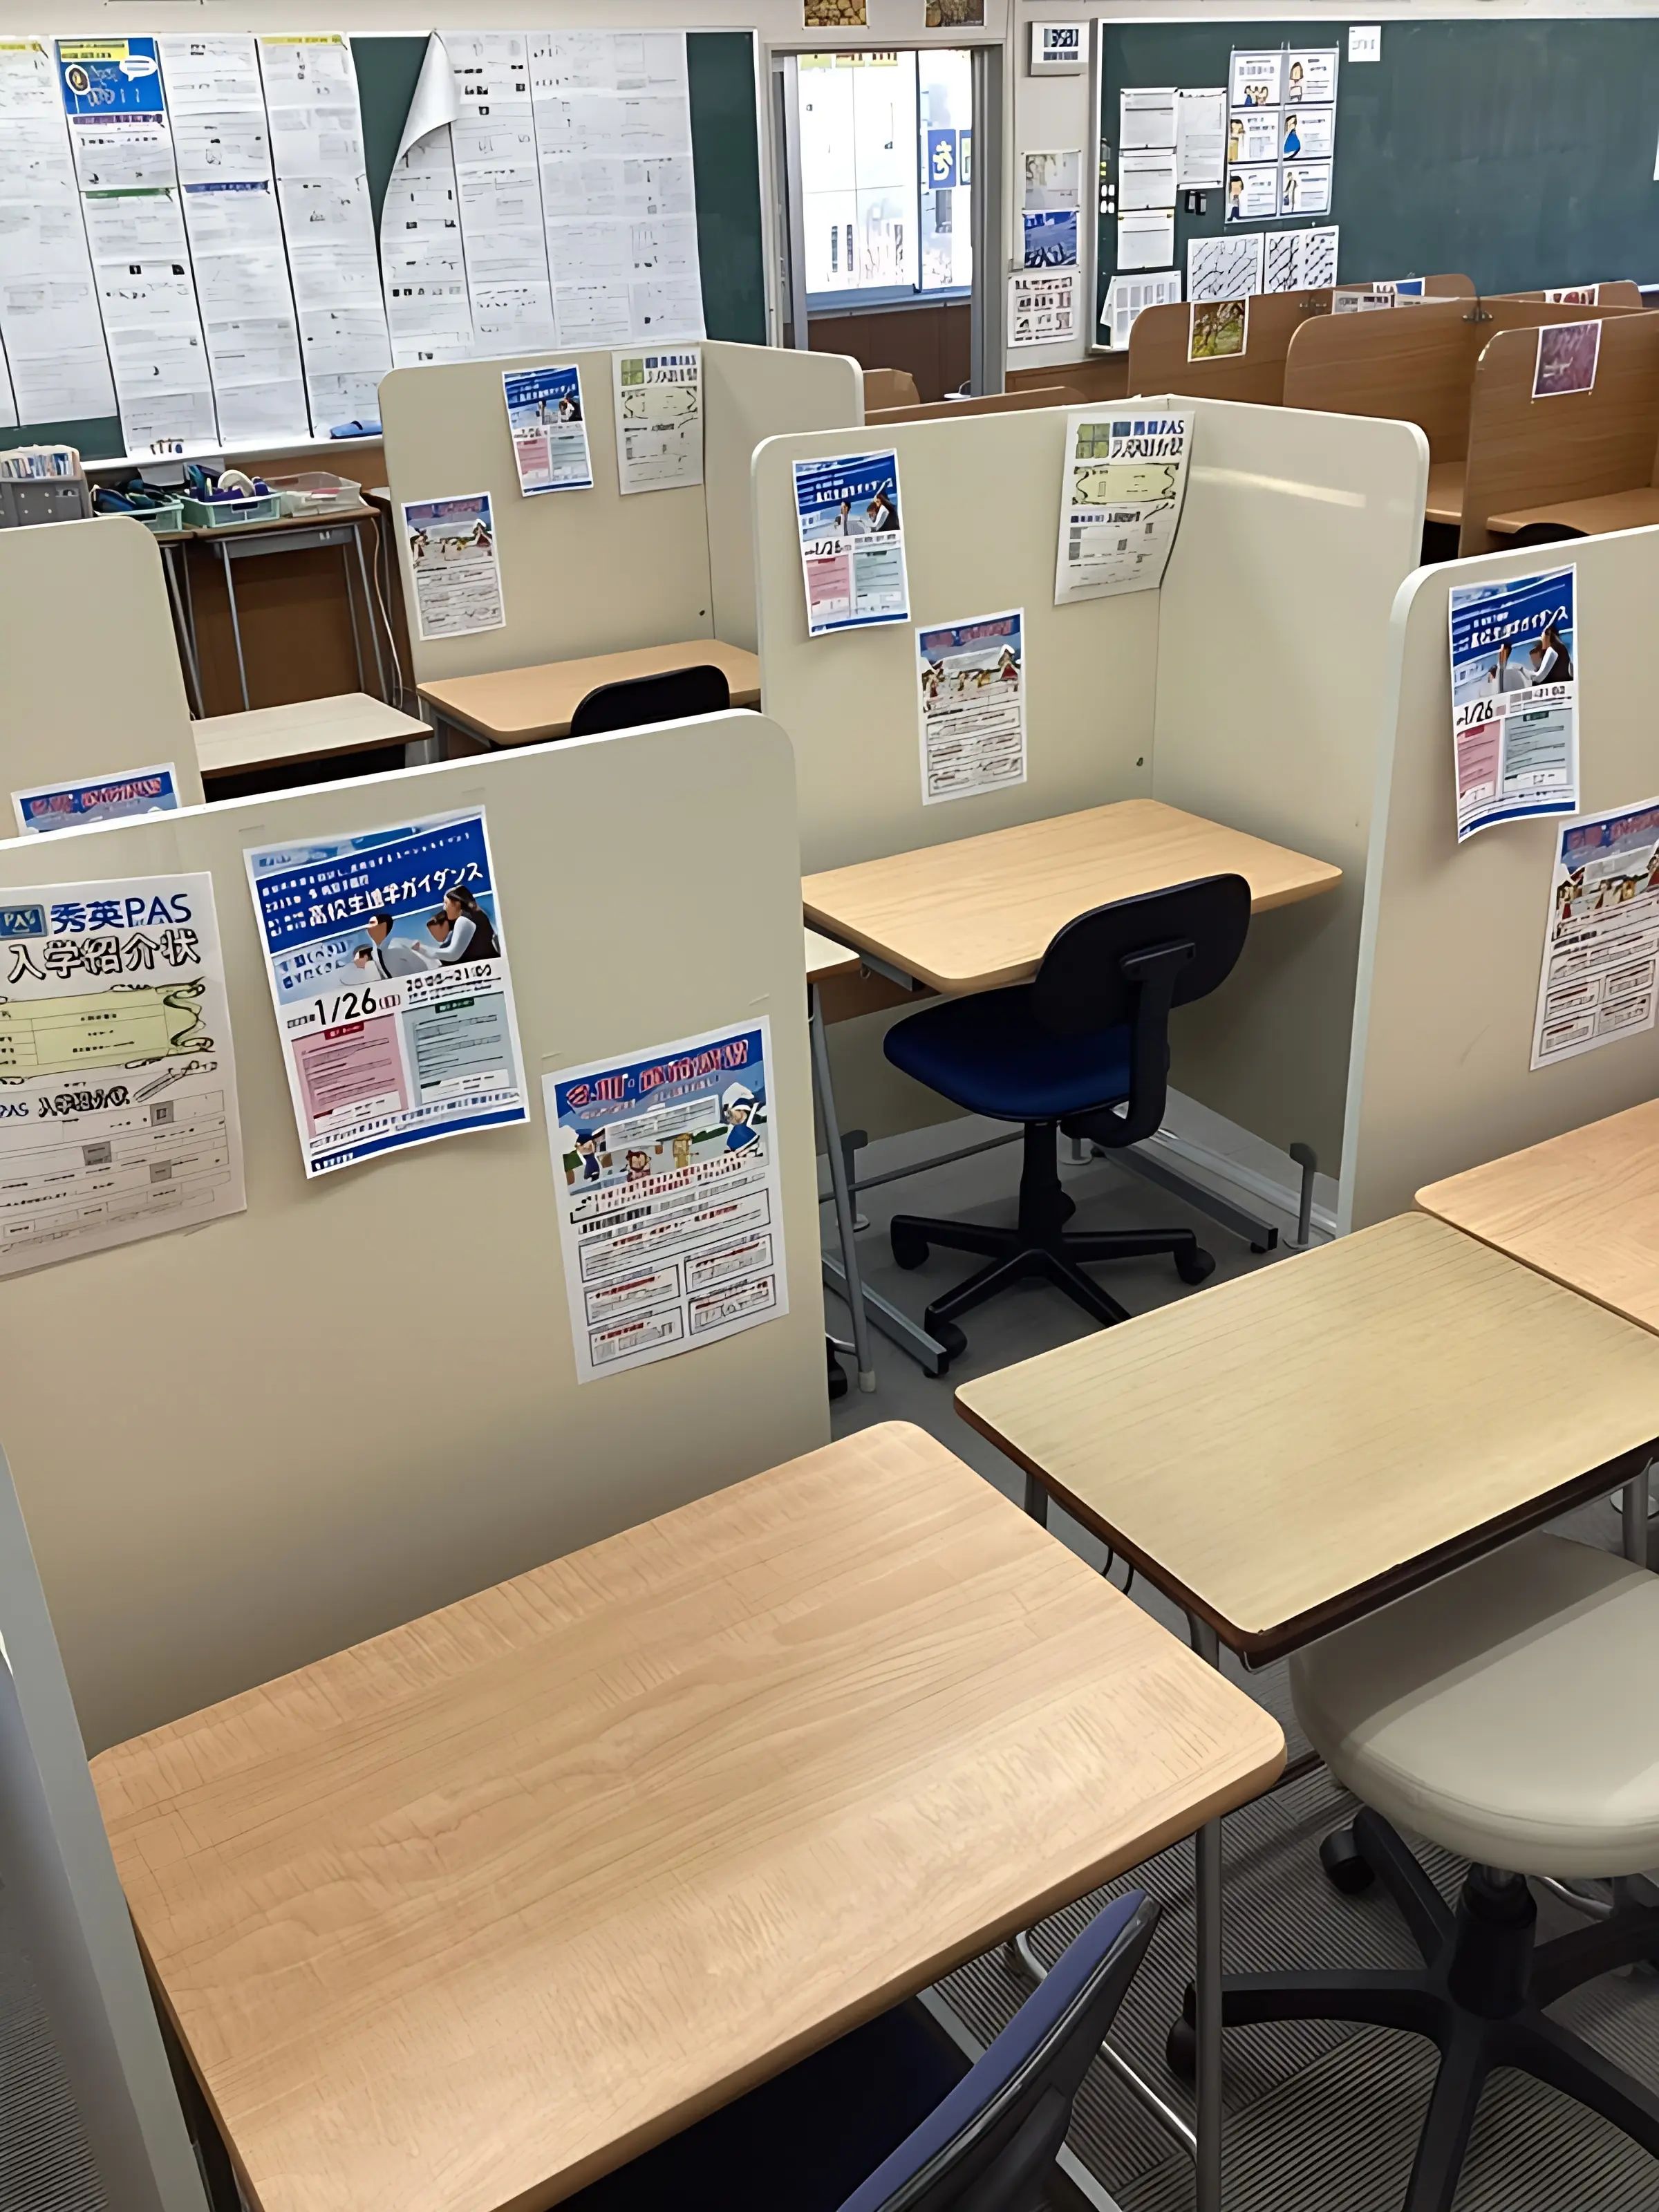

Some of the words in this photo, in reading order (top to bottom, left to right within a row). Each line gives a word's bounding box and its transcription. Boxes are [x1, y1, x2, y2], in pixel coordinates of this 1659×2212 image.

[50, 893, 191, 934] 秀英PAS
[8, 928, 201, 983] 入学紹介状
[314, 987, 377, 1025] 1/26
